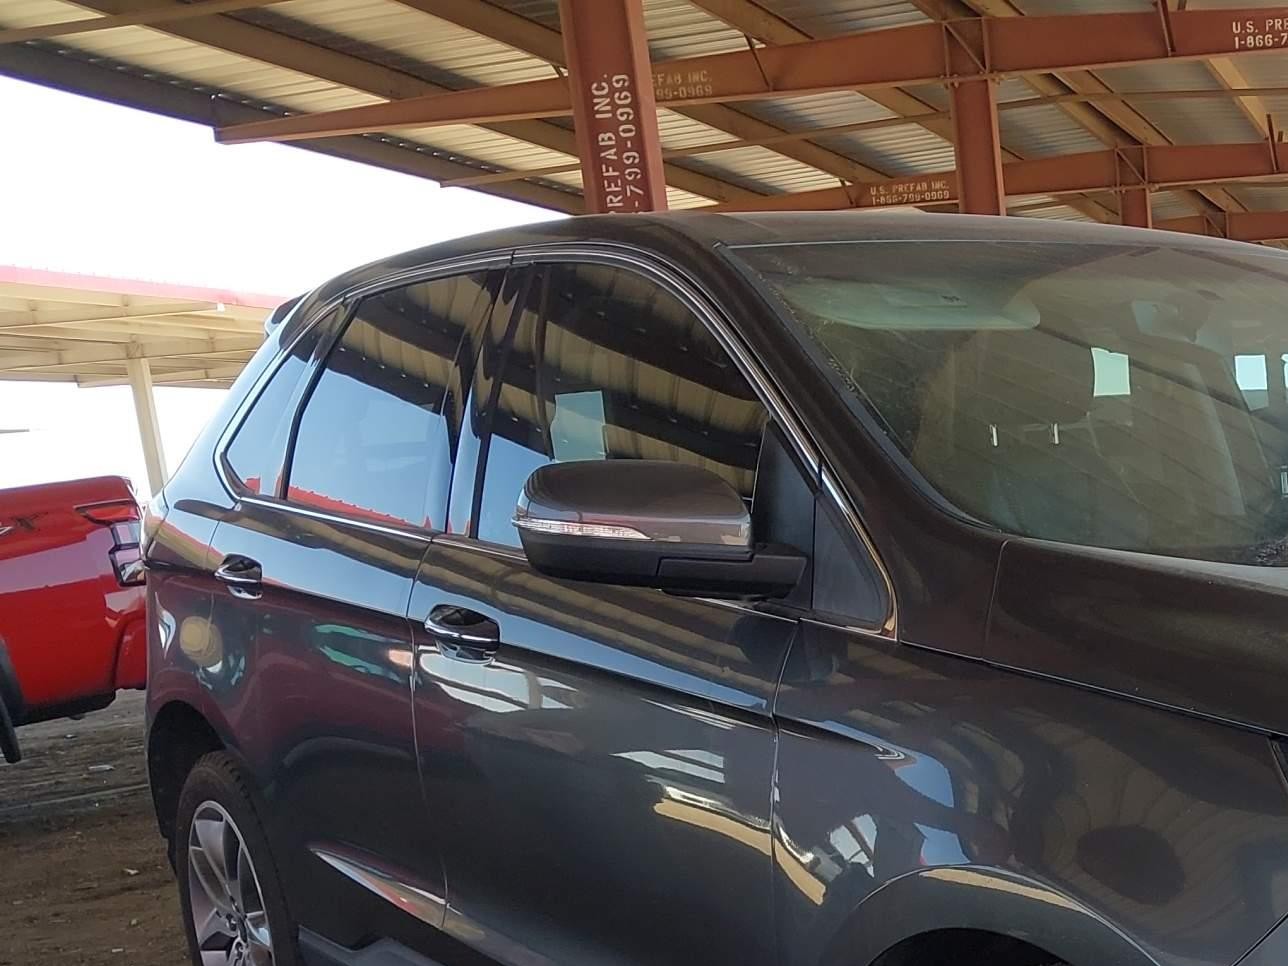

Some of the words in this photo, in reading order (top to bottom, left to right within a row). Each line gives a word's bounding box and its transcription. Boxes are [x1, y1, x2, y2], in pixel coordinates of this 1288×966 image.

[1232, 20, 1259, 34] U.S.
[591, 73, 613, 119] INC.
[597, 131, 625, 214] REFAB
[612, 74, 644, 214] -799-0969
